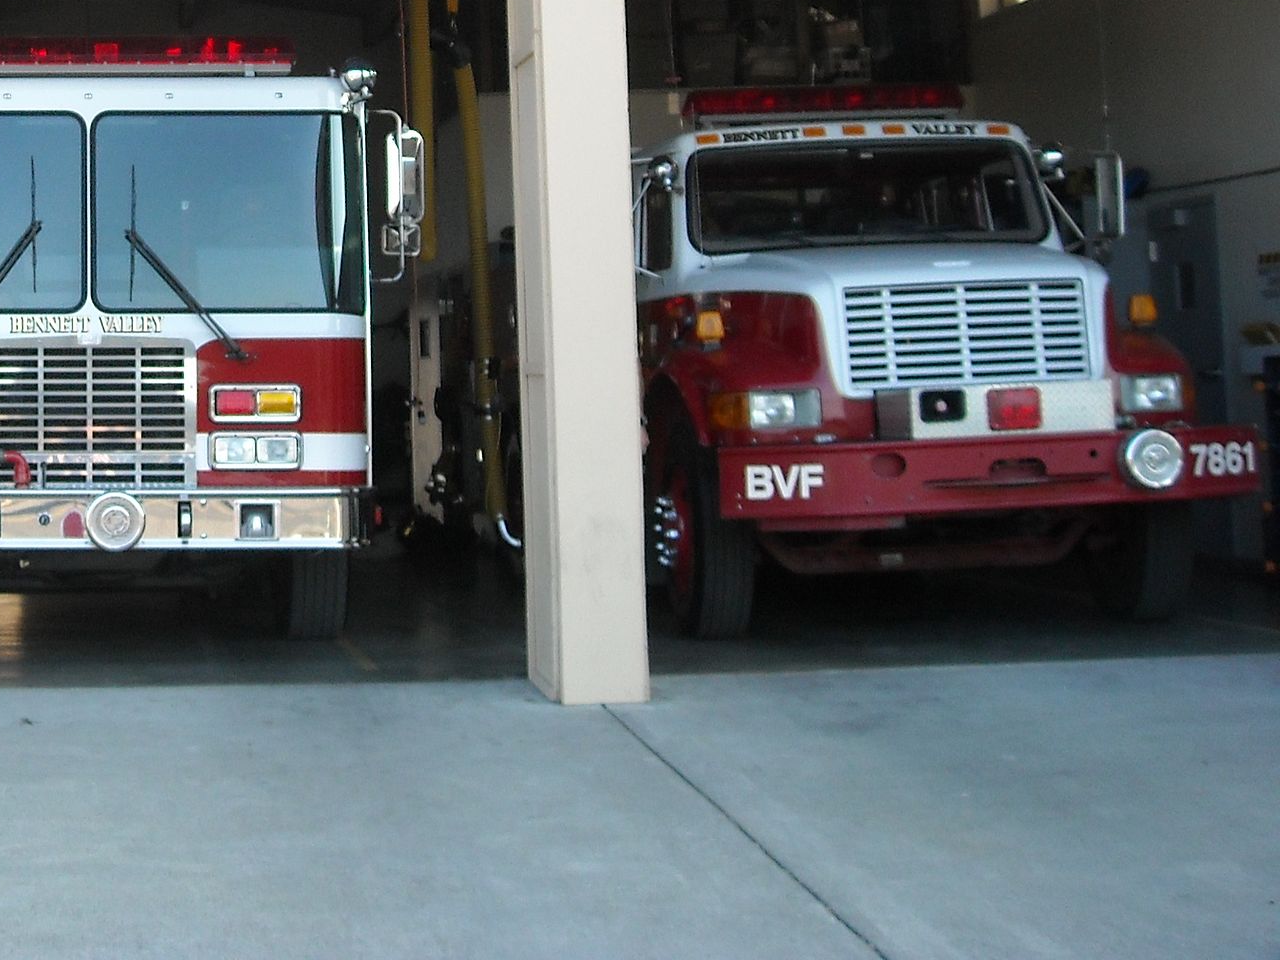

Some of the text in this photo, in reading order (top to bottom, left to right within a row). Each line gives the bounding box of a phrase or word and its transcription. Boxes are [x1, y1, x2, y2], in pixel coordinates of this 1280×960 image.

[723, 120, 979, 144] BENNETT VALLEY
[9, 316, 165, 334] BENNETT VALLEY
[1190, 441, 1256, 477] 7861
[744, 464, 825, 500] BVF
